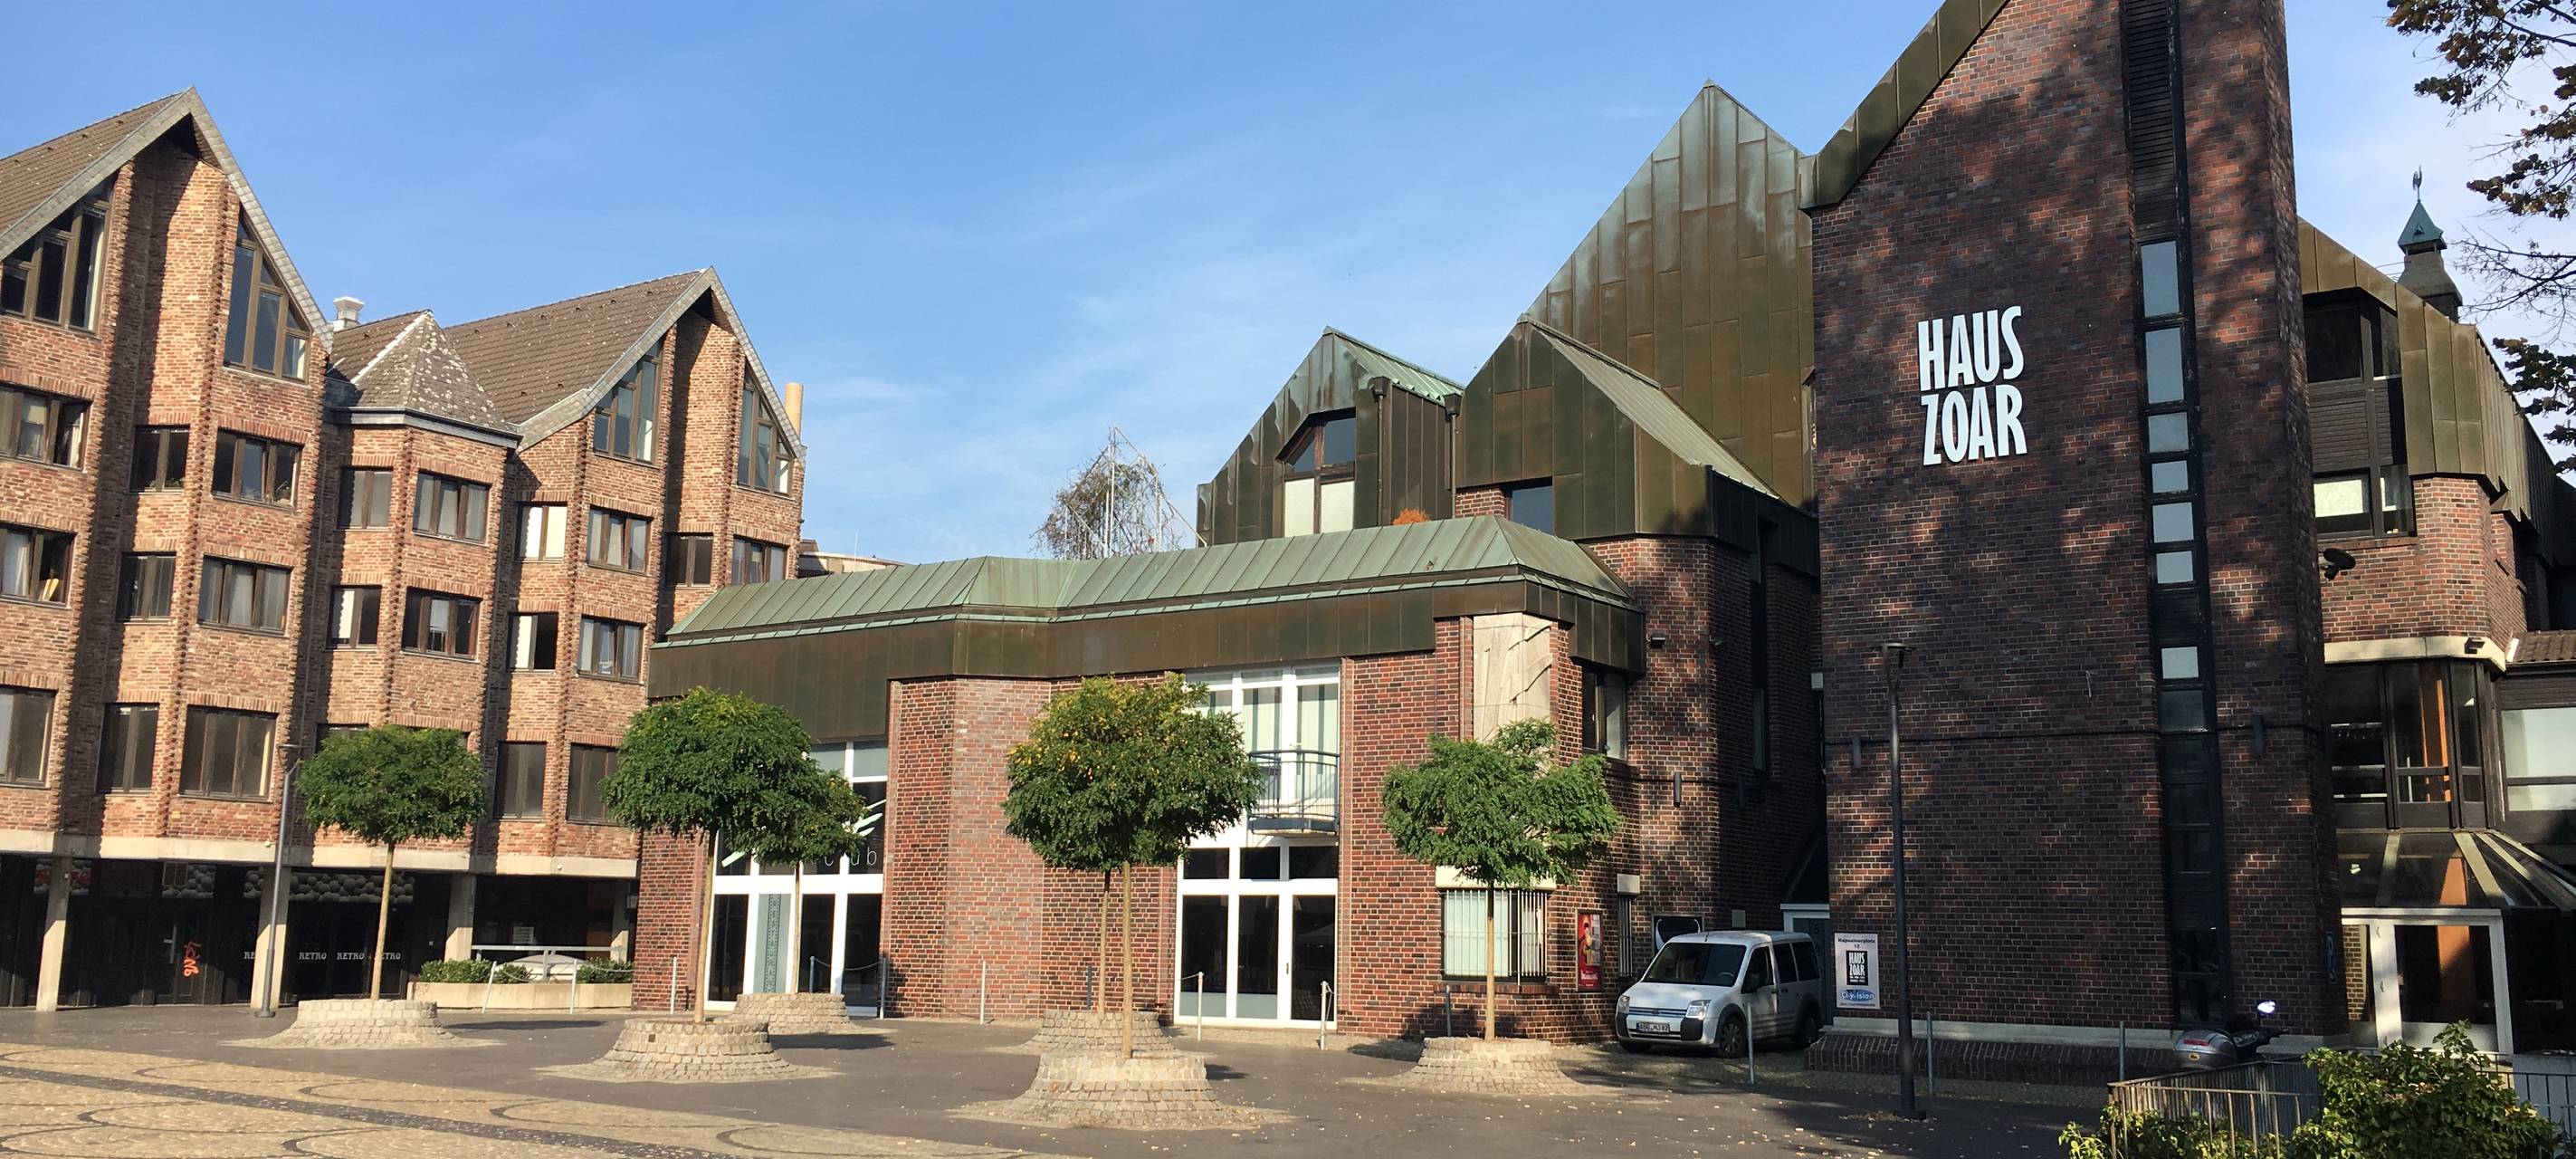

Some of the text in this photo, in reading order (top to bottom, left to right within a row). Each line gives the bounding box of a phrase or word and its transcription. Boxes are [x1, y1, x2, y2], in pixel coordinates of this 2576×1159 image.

[1918, 306, 2024, 391] HAUS
[1921, 384, 2027, 466] ZOAR
[824, 847, 877, 866] cub
[299, 952, 327, 960] RETRO
[337, 952, 365, 960] RETRO
[1848, 952, 1865, 964] HAUS
[1849, 963, 1865, 976] ZOAR
